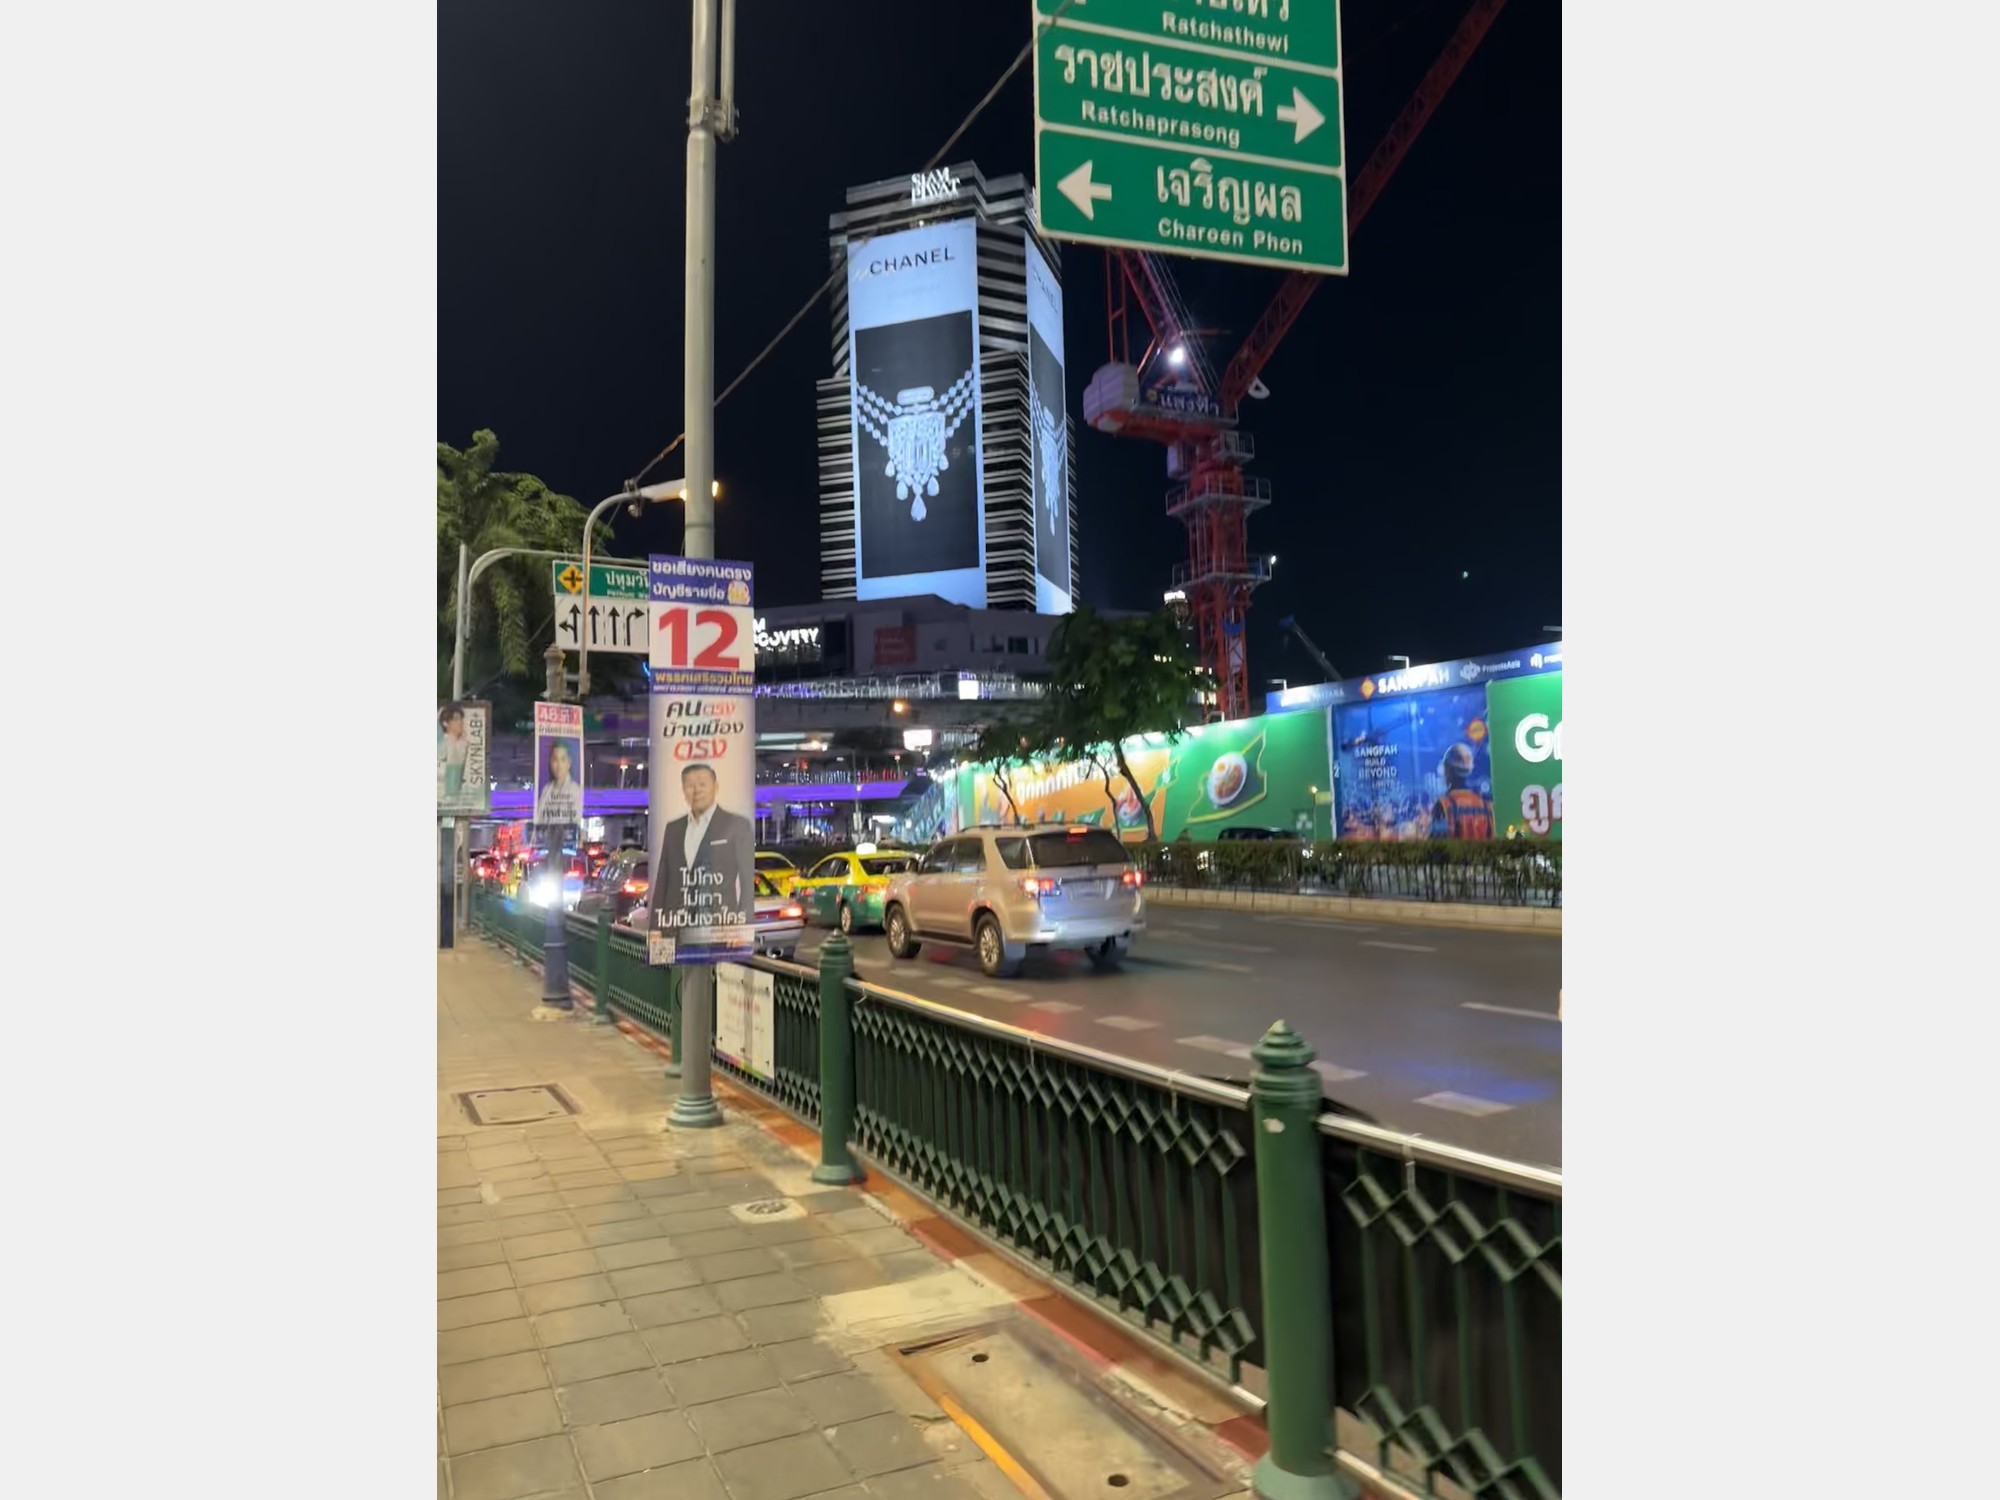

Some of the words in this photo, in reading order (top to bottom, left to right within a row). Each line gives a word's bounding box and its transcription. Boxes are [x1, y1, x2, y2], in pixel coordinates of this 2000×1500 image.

[1162, 11, 1289, 53] Ratchathewi
[1054, 44, 1268, 117] ราชประสงค์
[1081, 100, 1241, 149] Ratchaprasong
[1156, 157, 1302, 225] เจริญผล
[1158, 217, 1244, 247] Charoen
[1253, 230, 1303, 255] Phon
[869, 246, 955, 275] CHANEL
[659, 607, 740, 669] 12
[663, 719, 744, 738] บ้านเมือง
[673, 738, 728, 761] ตรง
[679, 867, 724, 886] ไม่โกง
